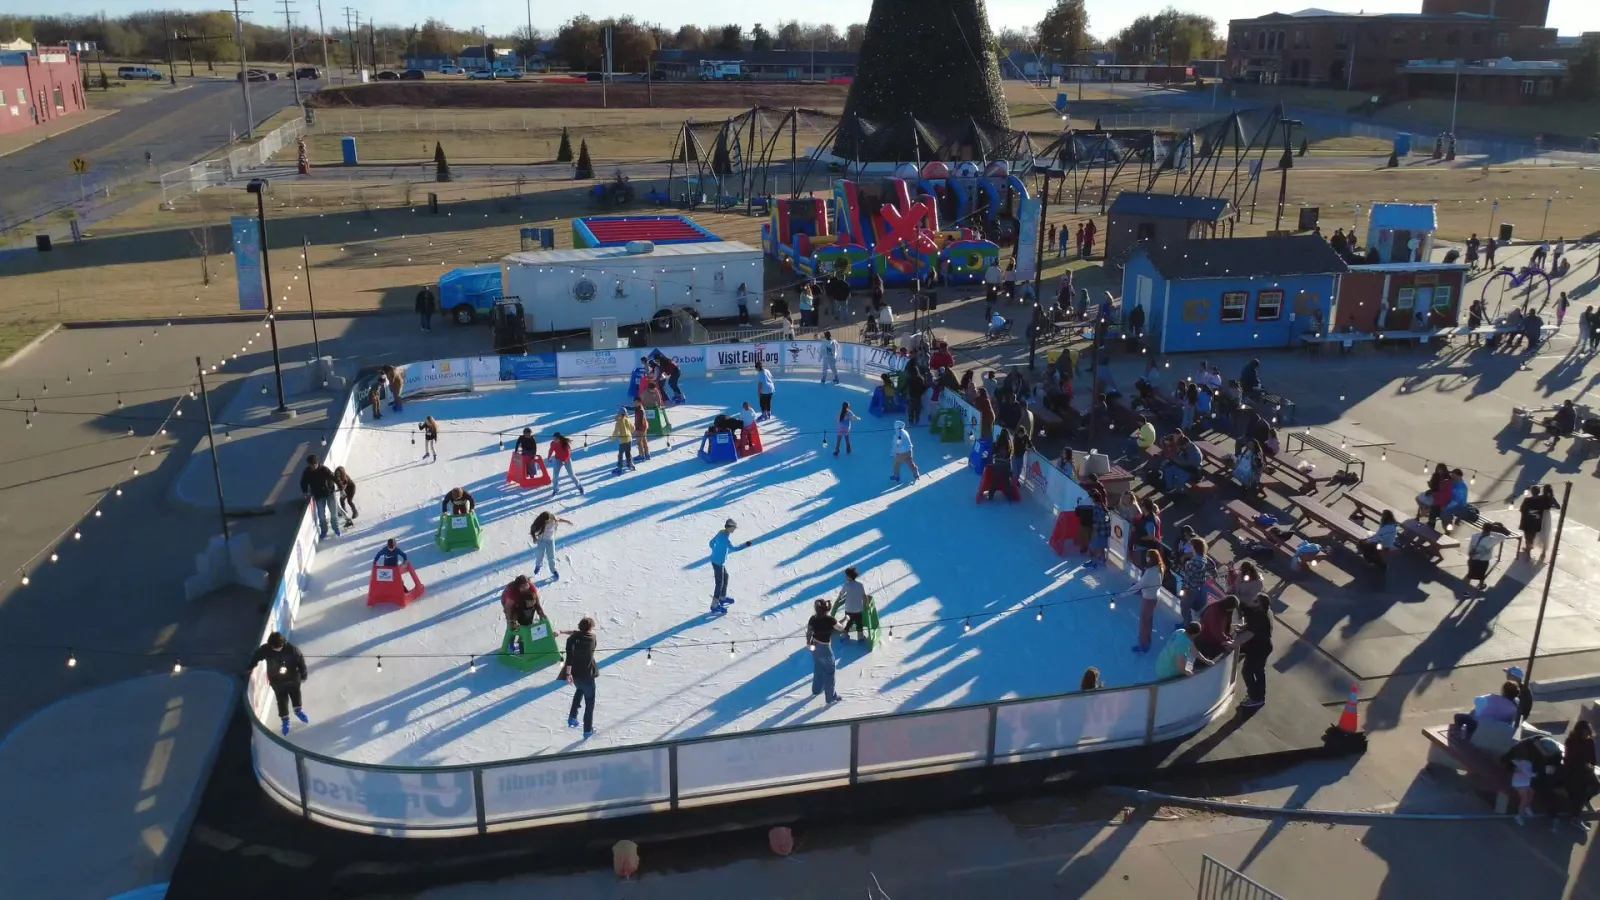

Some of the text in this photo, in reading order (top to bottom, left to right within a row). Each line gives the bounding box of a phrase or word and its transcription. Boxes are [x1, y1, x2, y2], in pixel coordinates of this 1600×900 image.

[671, 355, 704, 364] Oxbow
[718, 348, 779, 365] Visit Enid.org
